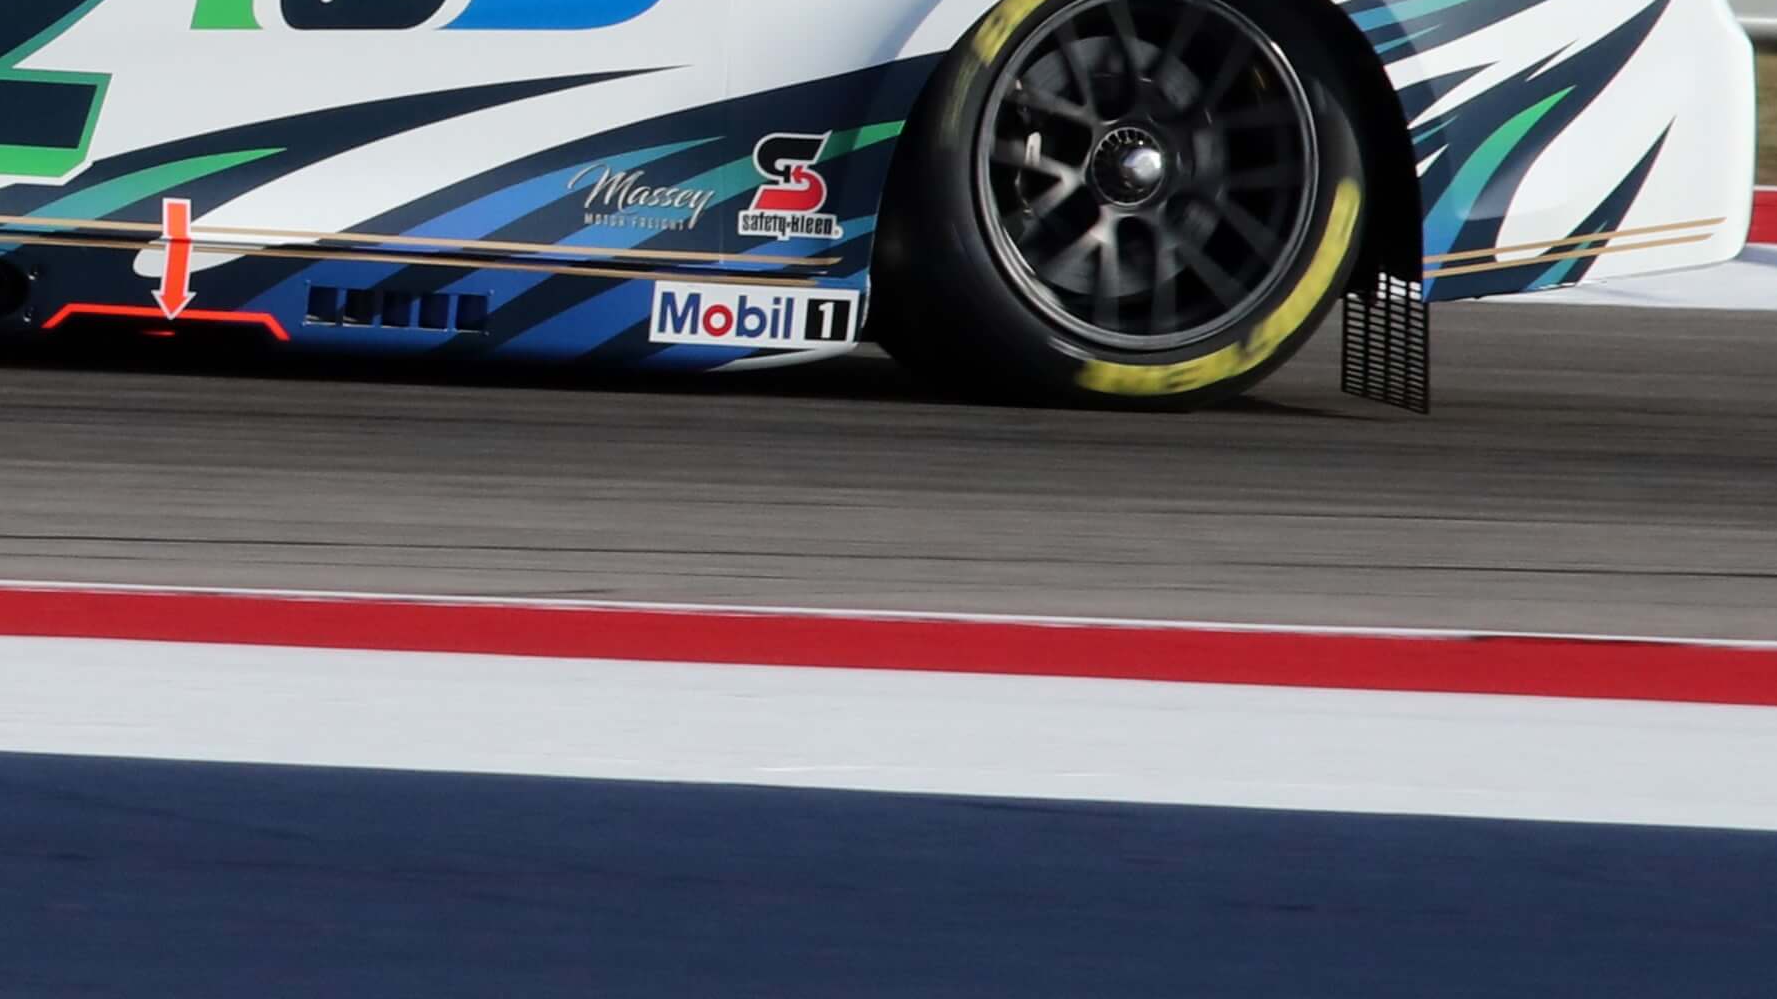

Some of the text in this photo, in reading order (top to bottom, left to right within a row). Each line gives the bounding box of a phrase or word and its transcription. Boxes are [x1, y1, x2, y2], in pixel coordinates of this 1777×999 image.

[567, 163, 715, 230] Massey
[584, 213, 685, 231] MOTOR FREIGHT
[657, 290, 836, 339] Mobil 1
